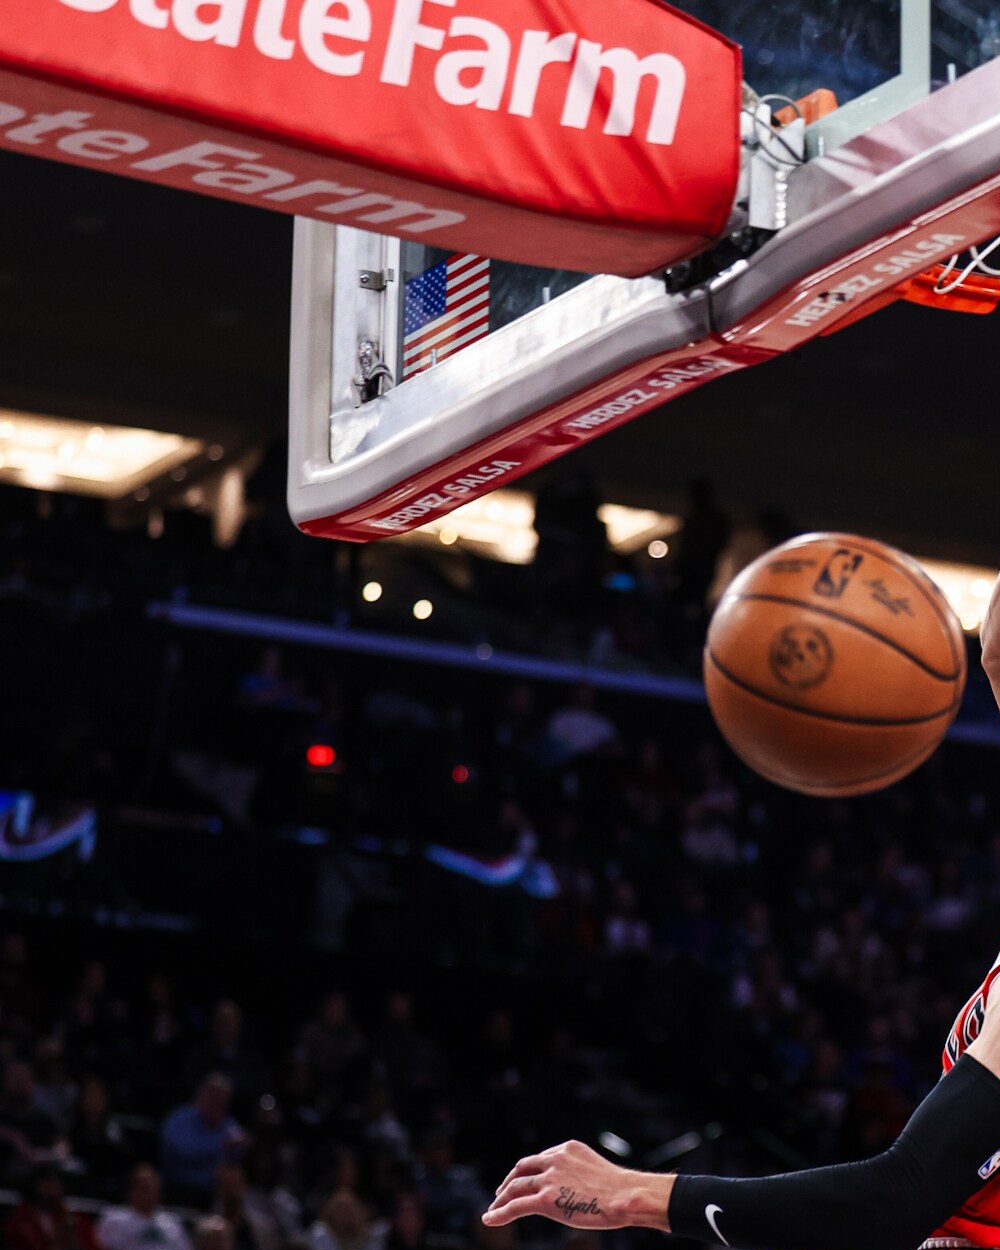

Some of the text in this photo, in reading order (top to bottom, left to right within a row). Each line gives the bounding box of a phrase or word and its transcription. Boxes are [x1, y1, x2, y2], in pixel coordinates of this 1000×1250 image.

[873, 233, 966, 275] SALSA
[567, 389, 659, 429] HERDEZ
[370, 460, 522, 529] HERDEZ SALSA
[554, 1186, 602, 1219] Elijah
